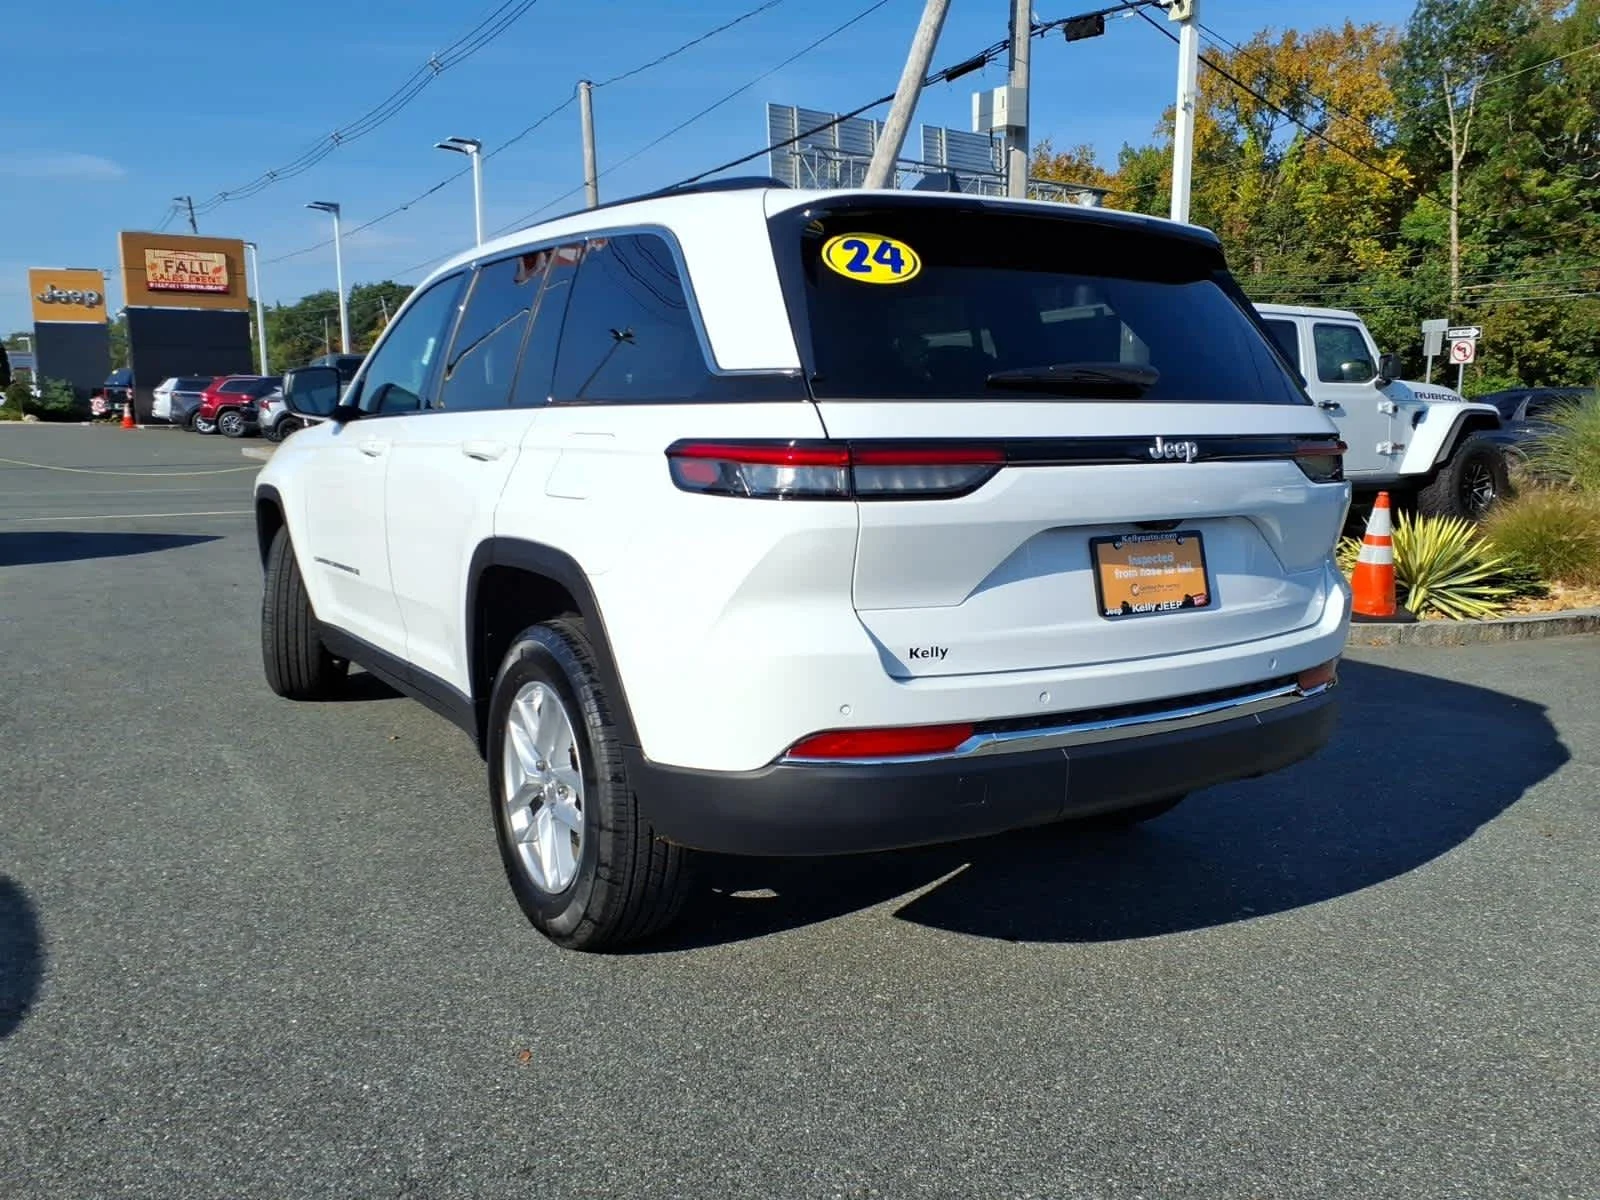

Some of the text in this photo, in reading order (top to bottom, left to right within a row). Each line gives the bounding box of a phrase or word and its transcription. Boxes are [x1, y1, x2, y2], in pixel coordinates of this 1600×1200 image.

[842, 239, 905, 274] 24
[163, 260, 209, 275] FALL
[37, 283, 100, 307] Jeep
[1414, 391, 1462, 402] RUBICON
[1149, 436, 1198, 463] Jeep
[1114, 568, 1138, 579] from
[1105, 607, 1123, 615] Jeep
[1132, 602, 1157, 613] Kelly
[1158, 600, 1183, 611] JEEP
[909, 646, 949, 660] Kelly
